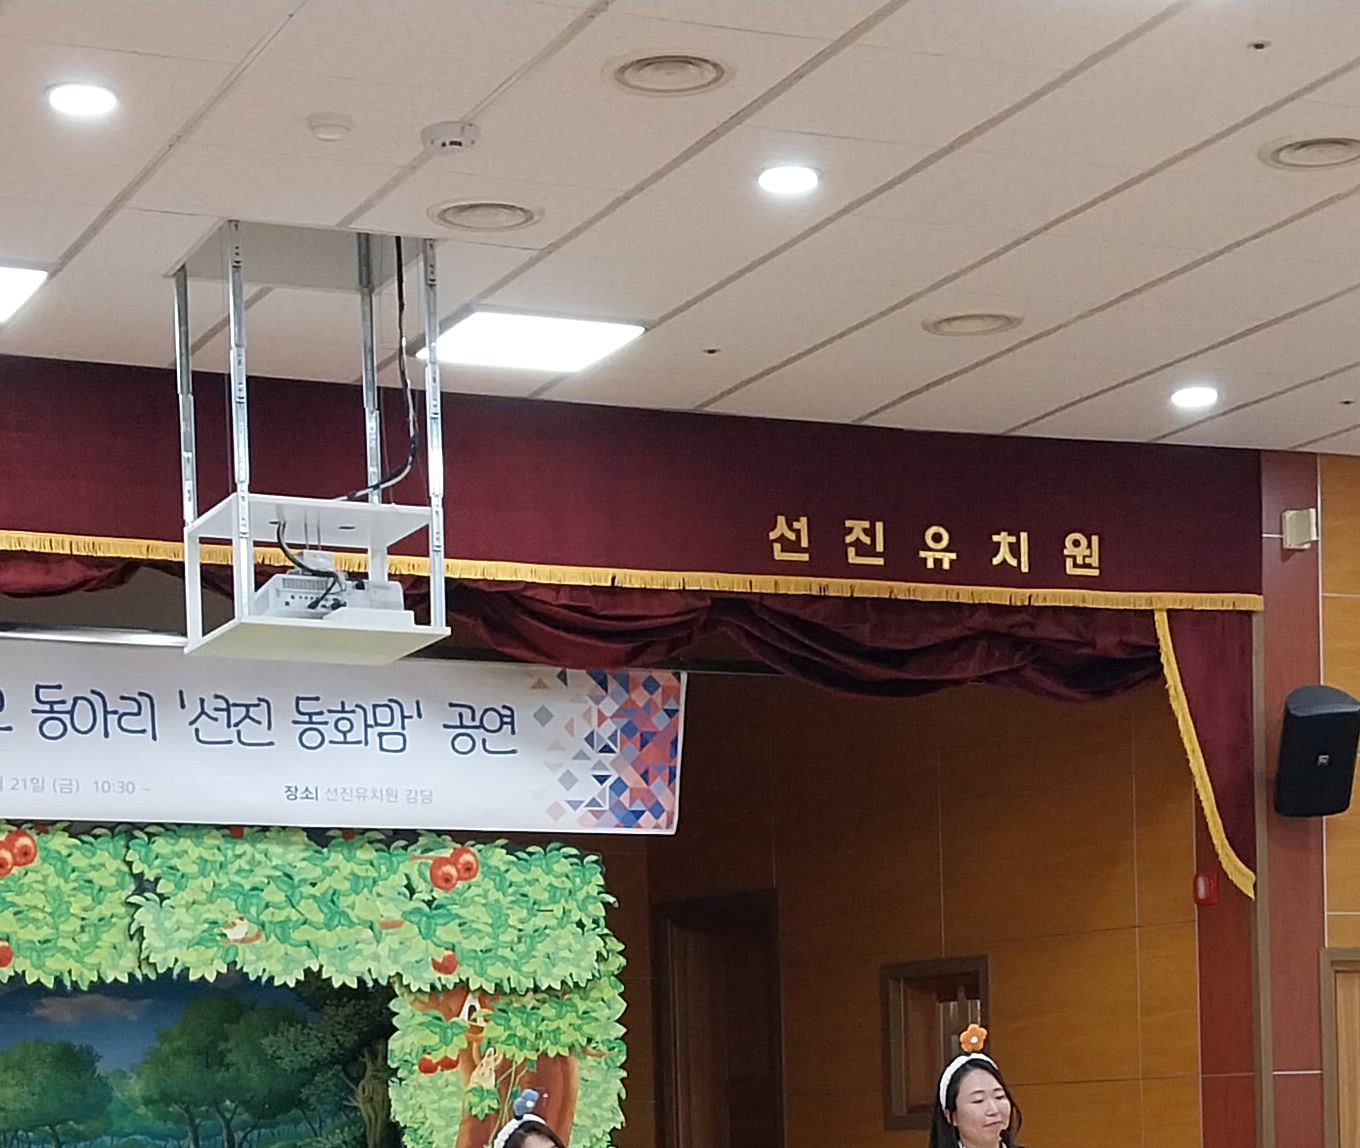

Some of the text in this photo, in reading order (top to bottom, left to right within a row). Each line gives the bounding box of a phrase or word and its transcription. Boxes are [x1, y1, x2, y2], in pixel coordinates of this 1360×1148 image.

[31, 684, 158, 742] 동아리
[442, 702, 519, 757] 공연
[10, 777, 46, 793] 21일
[52, 778, 80, 794] (금)
[94, 780, 136, 795] 10:30
[325, 786, 399, 803] 선진유치원
